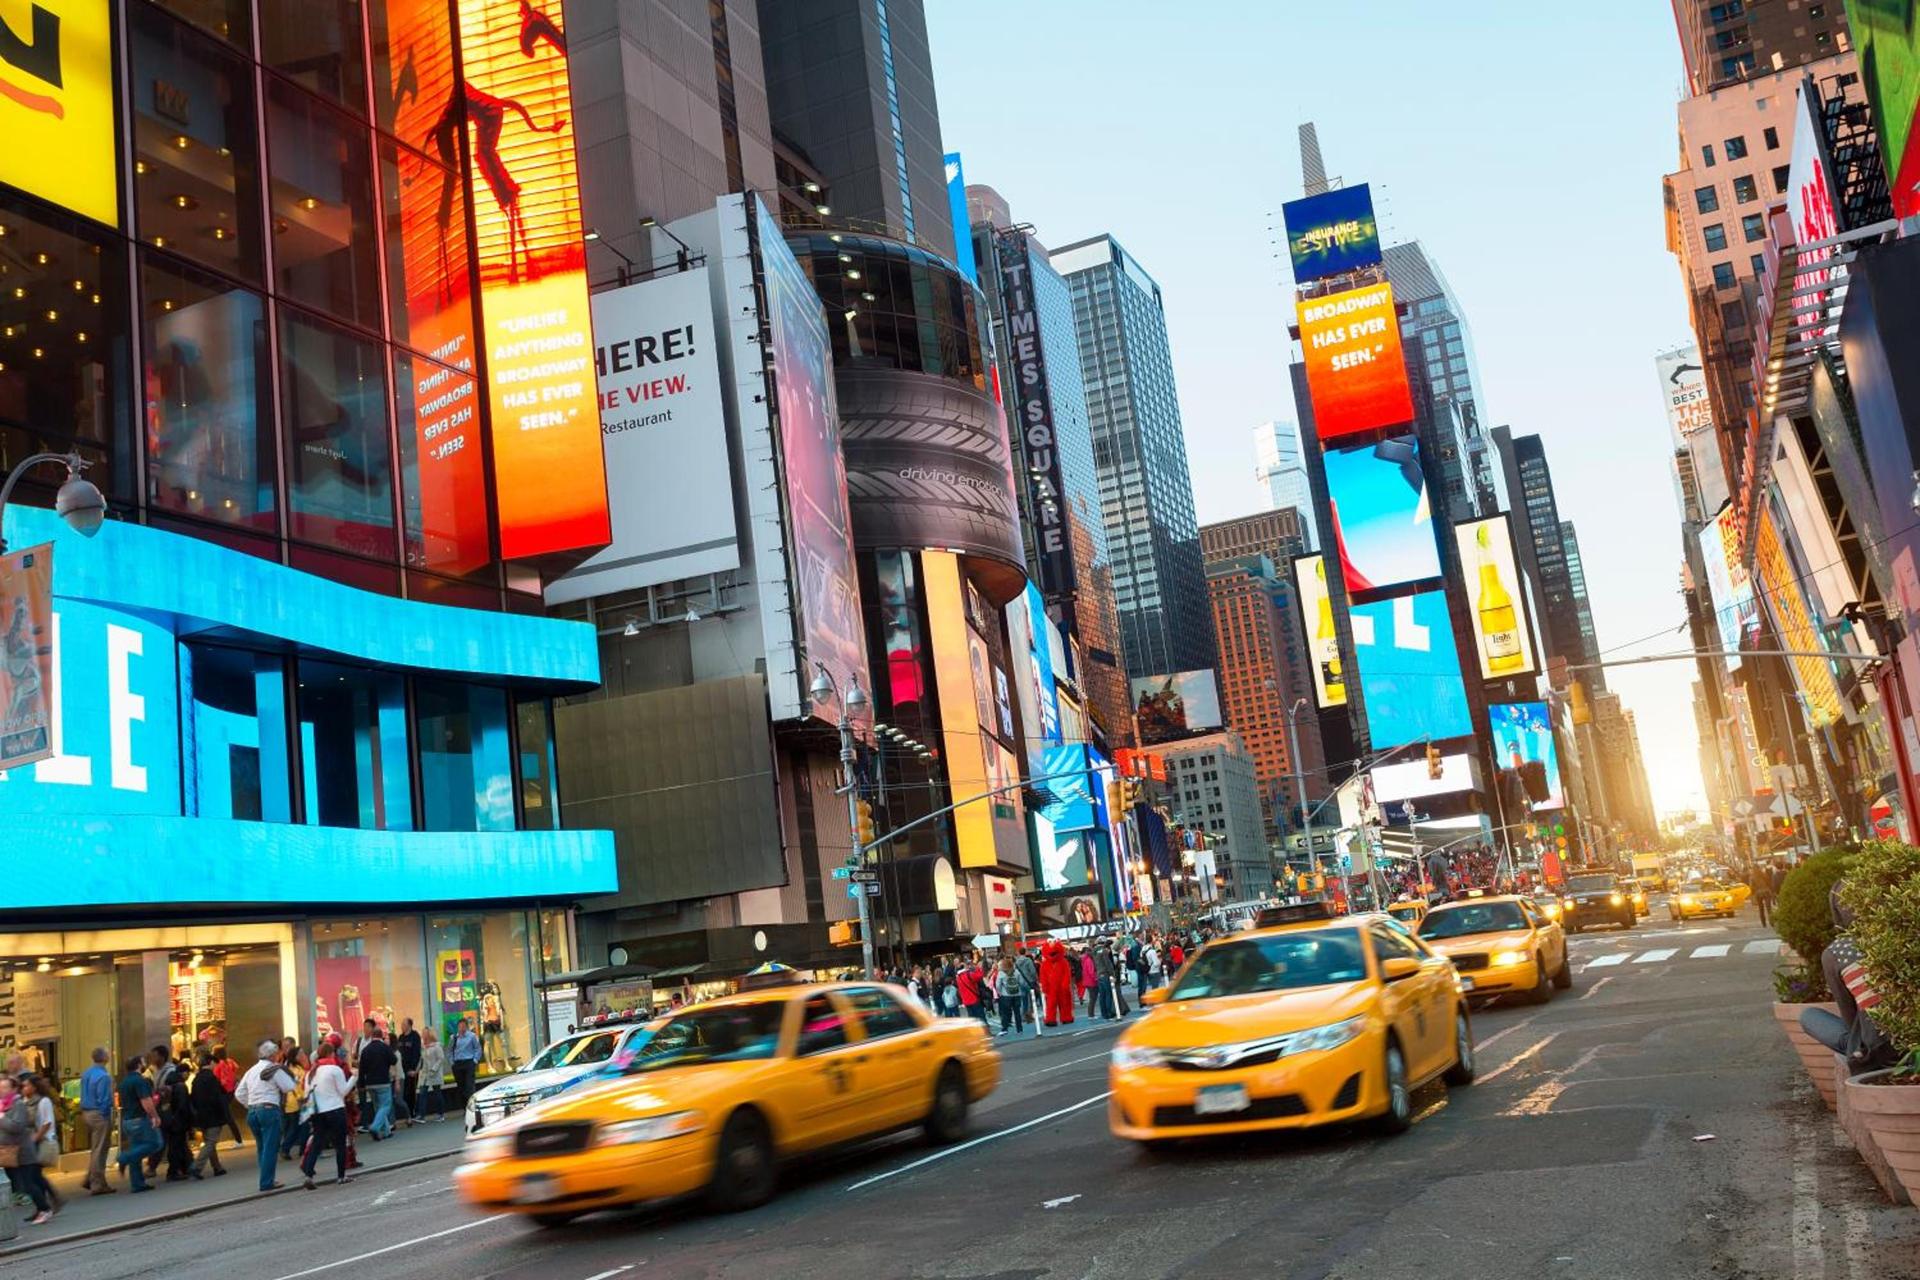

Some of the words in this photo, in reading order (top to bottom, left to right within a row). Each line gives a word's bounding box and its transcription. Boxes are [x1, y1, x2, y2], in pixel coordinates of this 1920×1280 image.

[1305, 221, 1358, 242] INSURANCE
[1304, 291, 1387, 323] BROADWAY
[499, 309, 568, 333] "UNLIKE
[1312, 327, 1346, 349] HAS
[1349, 317, 1386, 339] EVER
[495, 332, 585, 360] ANYTHING
[1331, 343, 1383, 371] SEEN."
[496, 357, 587, 384] BROADWAY
[503, 389, 537, 409] HAS
[543, 382, 583, 402] EVER
[626, 374, 691, 404] VIEW.
[1673, 389, 1703, 405] BEST
[520, 408, 577, 431] SEEN."
[1005, 264, 1039, 384] TIMES
[1027, 400, 1063, 553] SQUARE
[1675, 399, 1711, 417] THE
[601, 409, 672, 435] Restaurant
[900, 467, 956, 485] driving
[0, 613, 147, 793] LE
